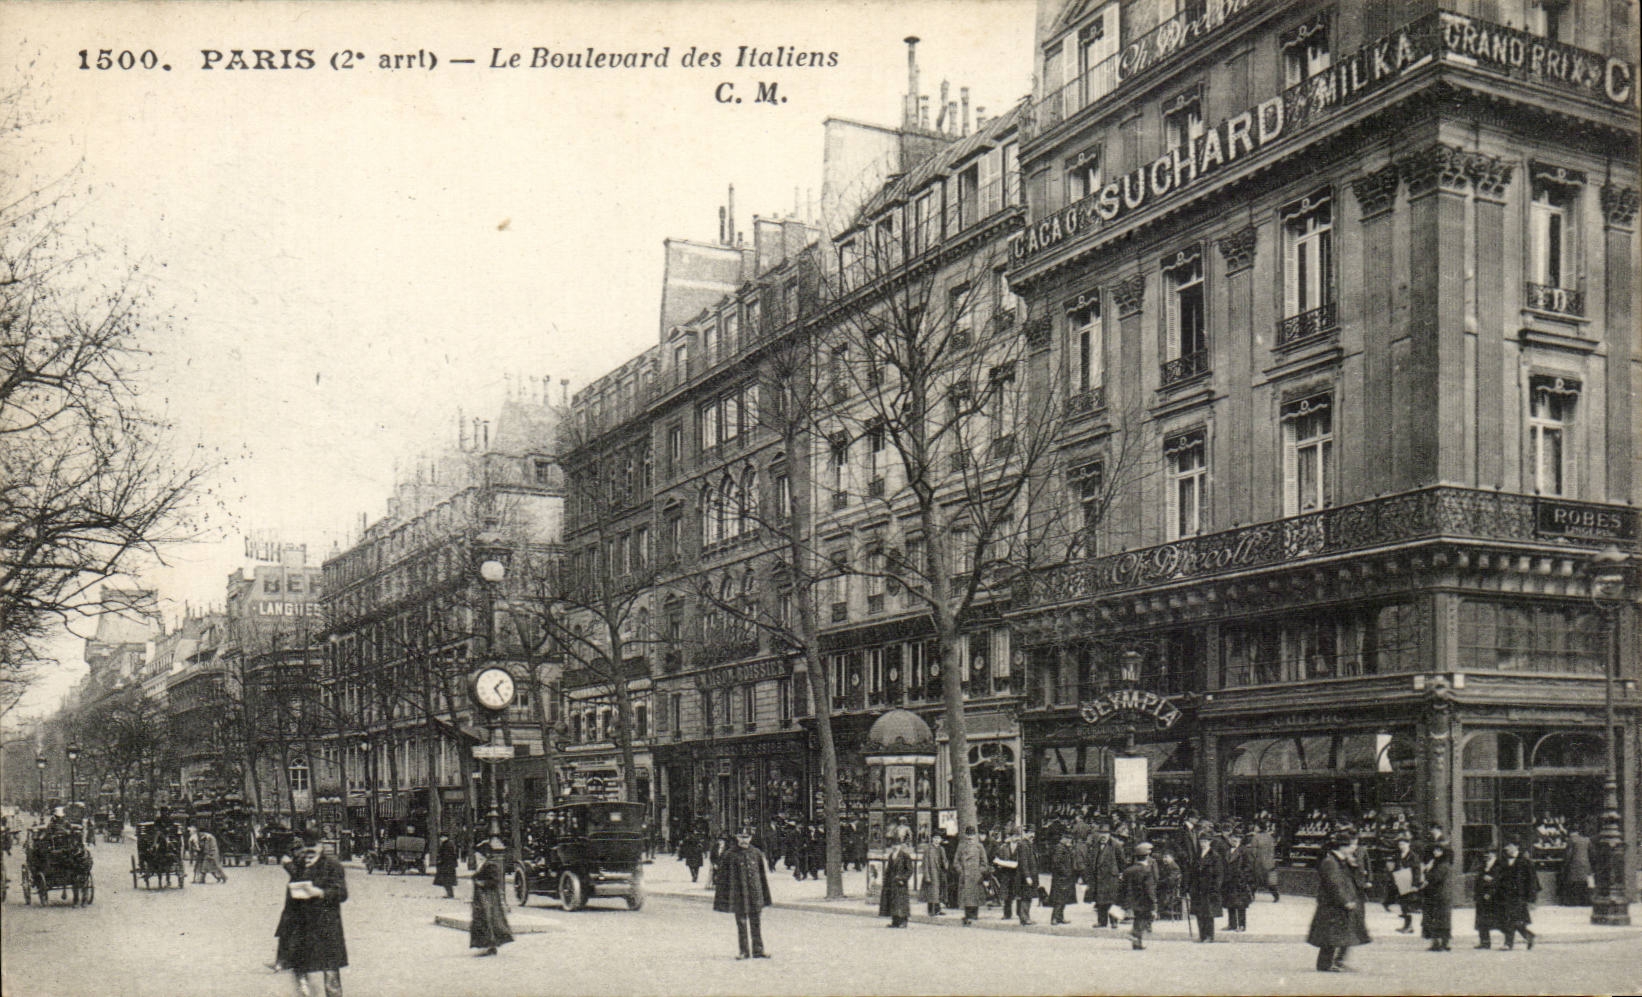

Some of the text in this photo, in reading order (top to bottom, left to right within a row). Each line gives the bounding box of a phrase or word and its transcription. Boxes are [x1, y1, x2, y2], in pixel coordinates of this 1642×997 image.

[1444, 21, 1525, 68] GRAND
[1531, 44, 1584, 84] PRIX
[1014, 33, 1416, 259] CACAO SUCHARD MILKA
[1553, 508, 1622, 529] ROBES
[1080, 689, 1181, 728] OLYMPIA
